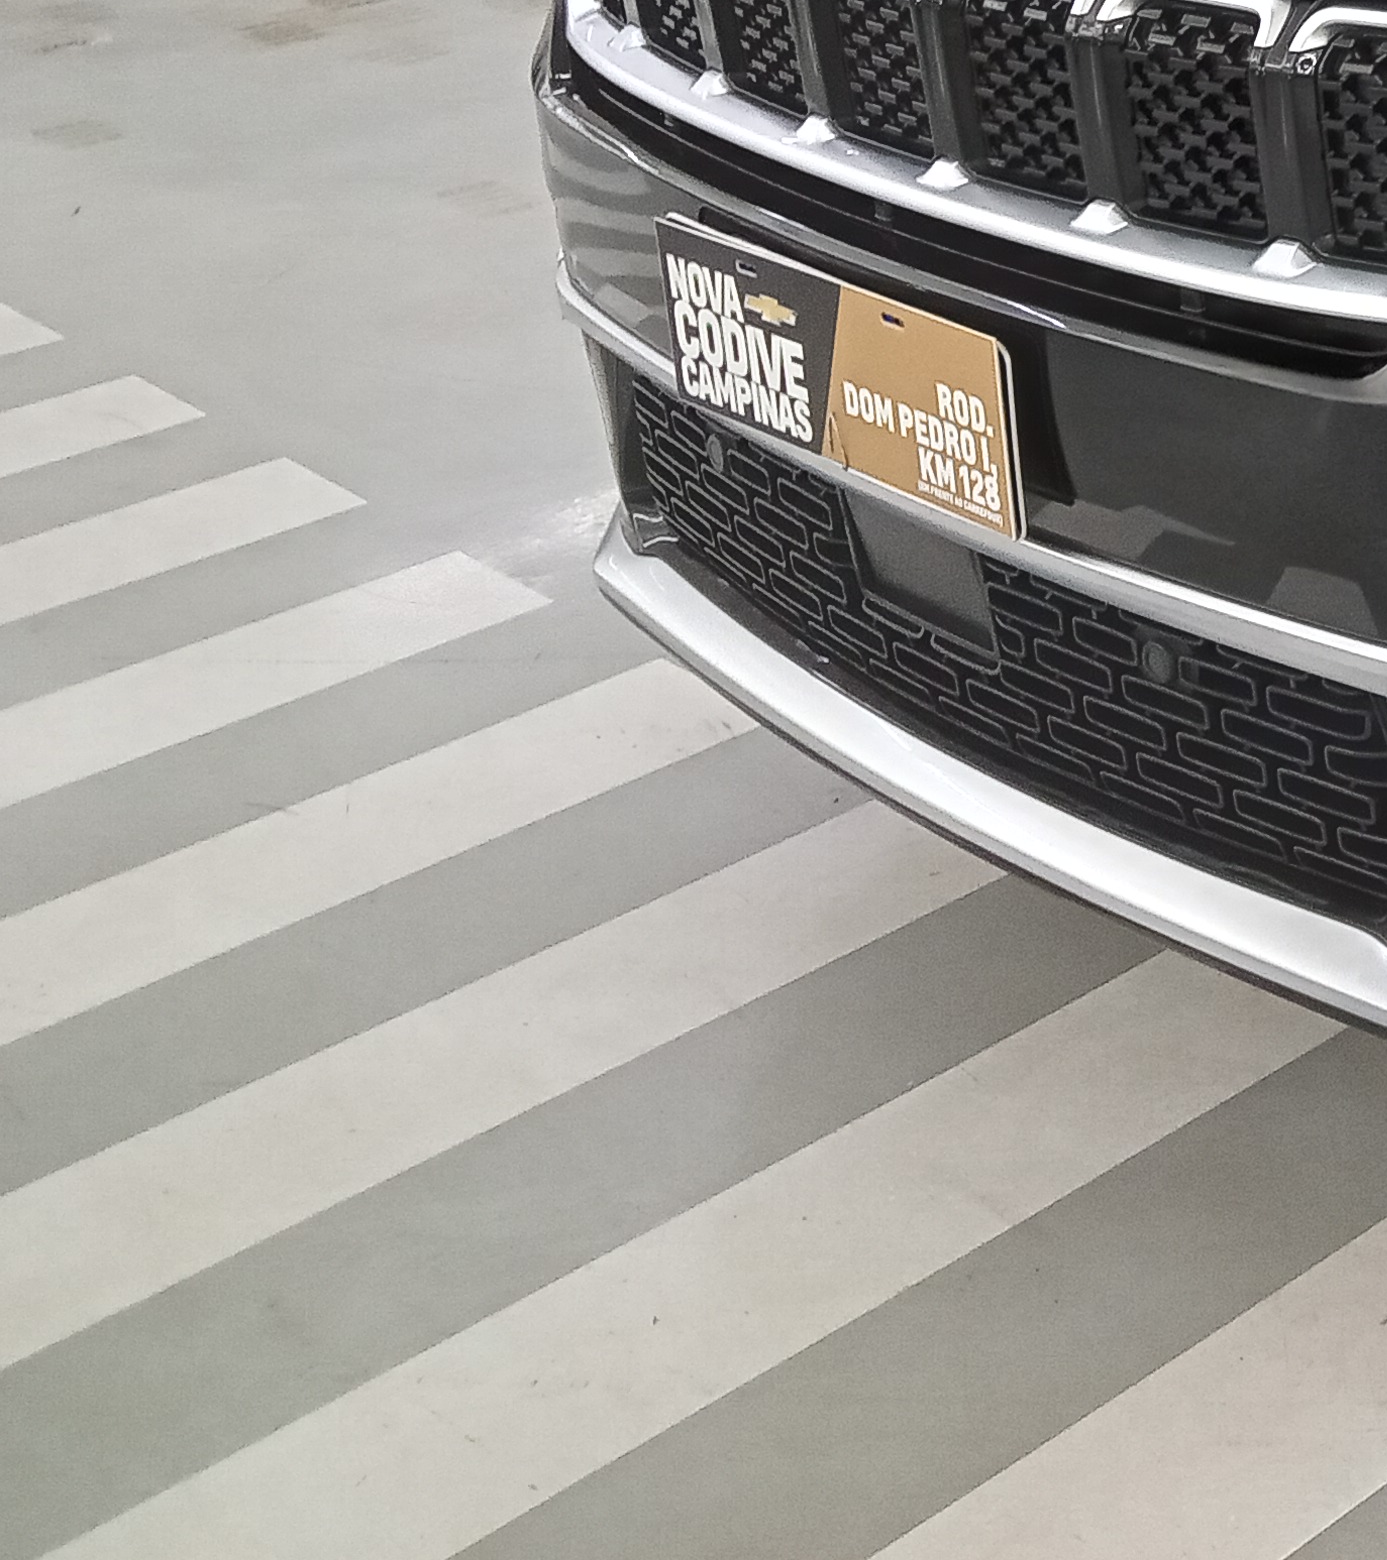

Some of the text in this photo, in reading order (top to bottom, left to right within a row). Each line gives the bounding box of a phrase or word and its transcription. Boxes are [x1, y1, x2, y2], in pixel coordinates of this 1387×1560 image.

[666, 253, 744, 323] NOVA
[674, 300, 809, 403] CODIVE
[681, 355, 813, 443] CAMPINAS
[842, 380, 895, 434] DOM
[897, 401, 977, 466] PEDRO
[935, 382, 994, 438] ROD.
[918, 445, 1001, 512] KM 128
